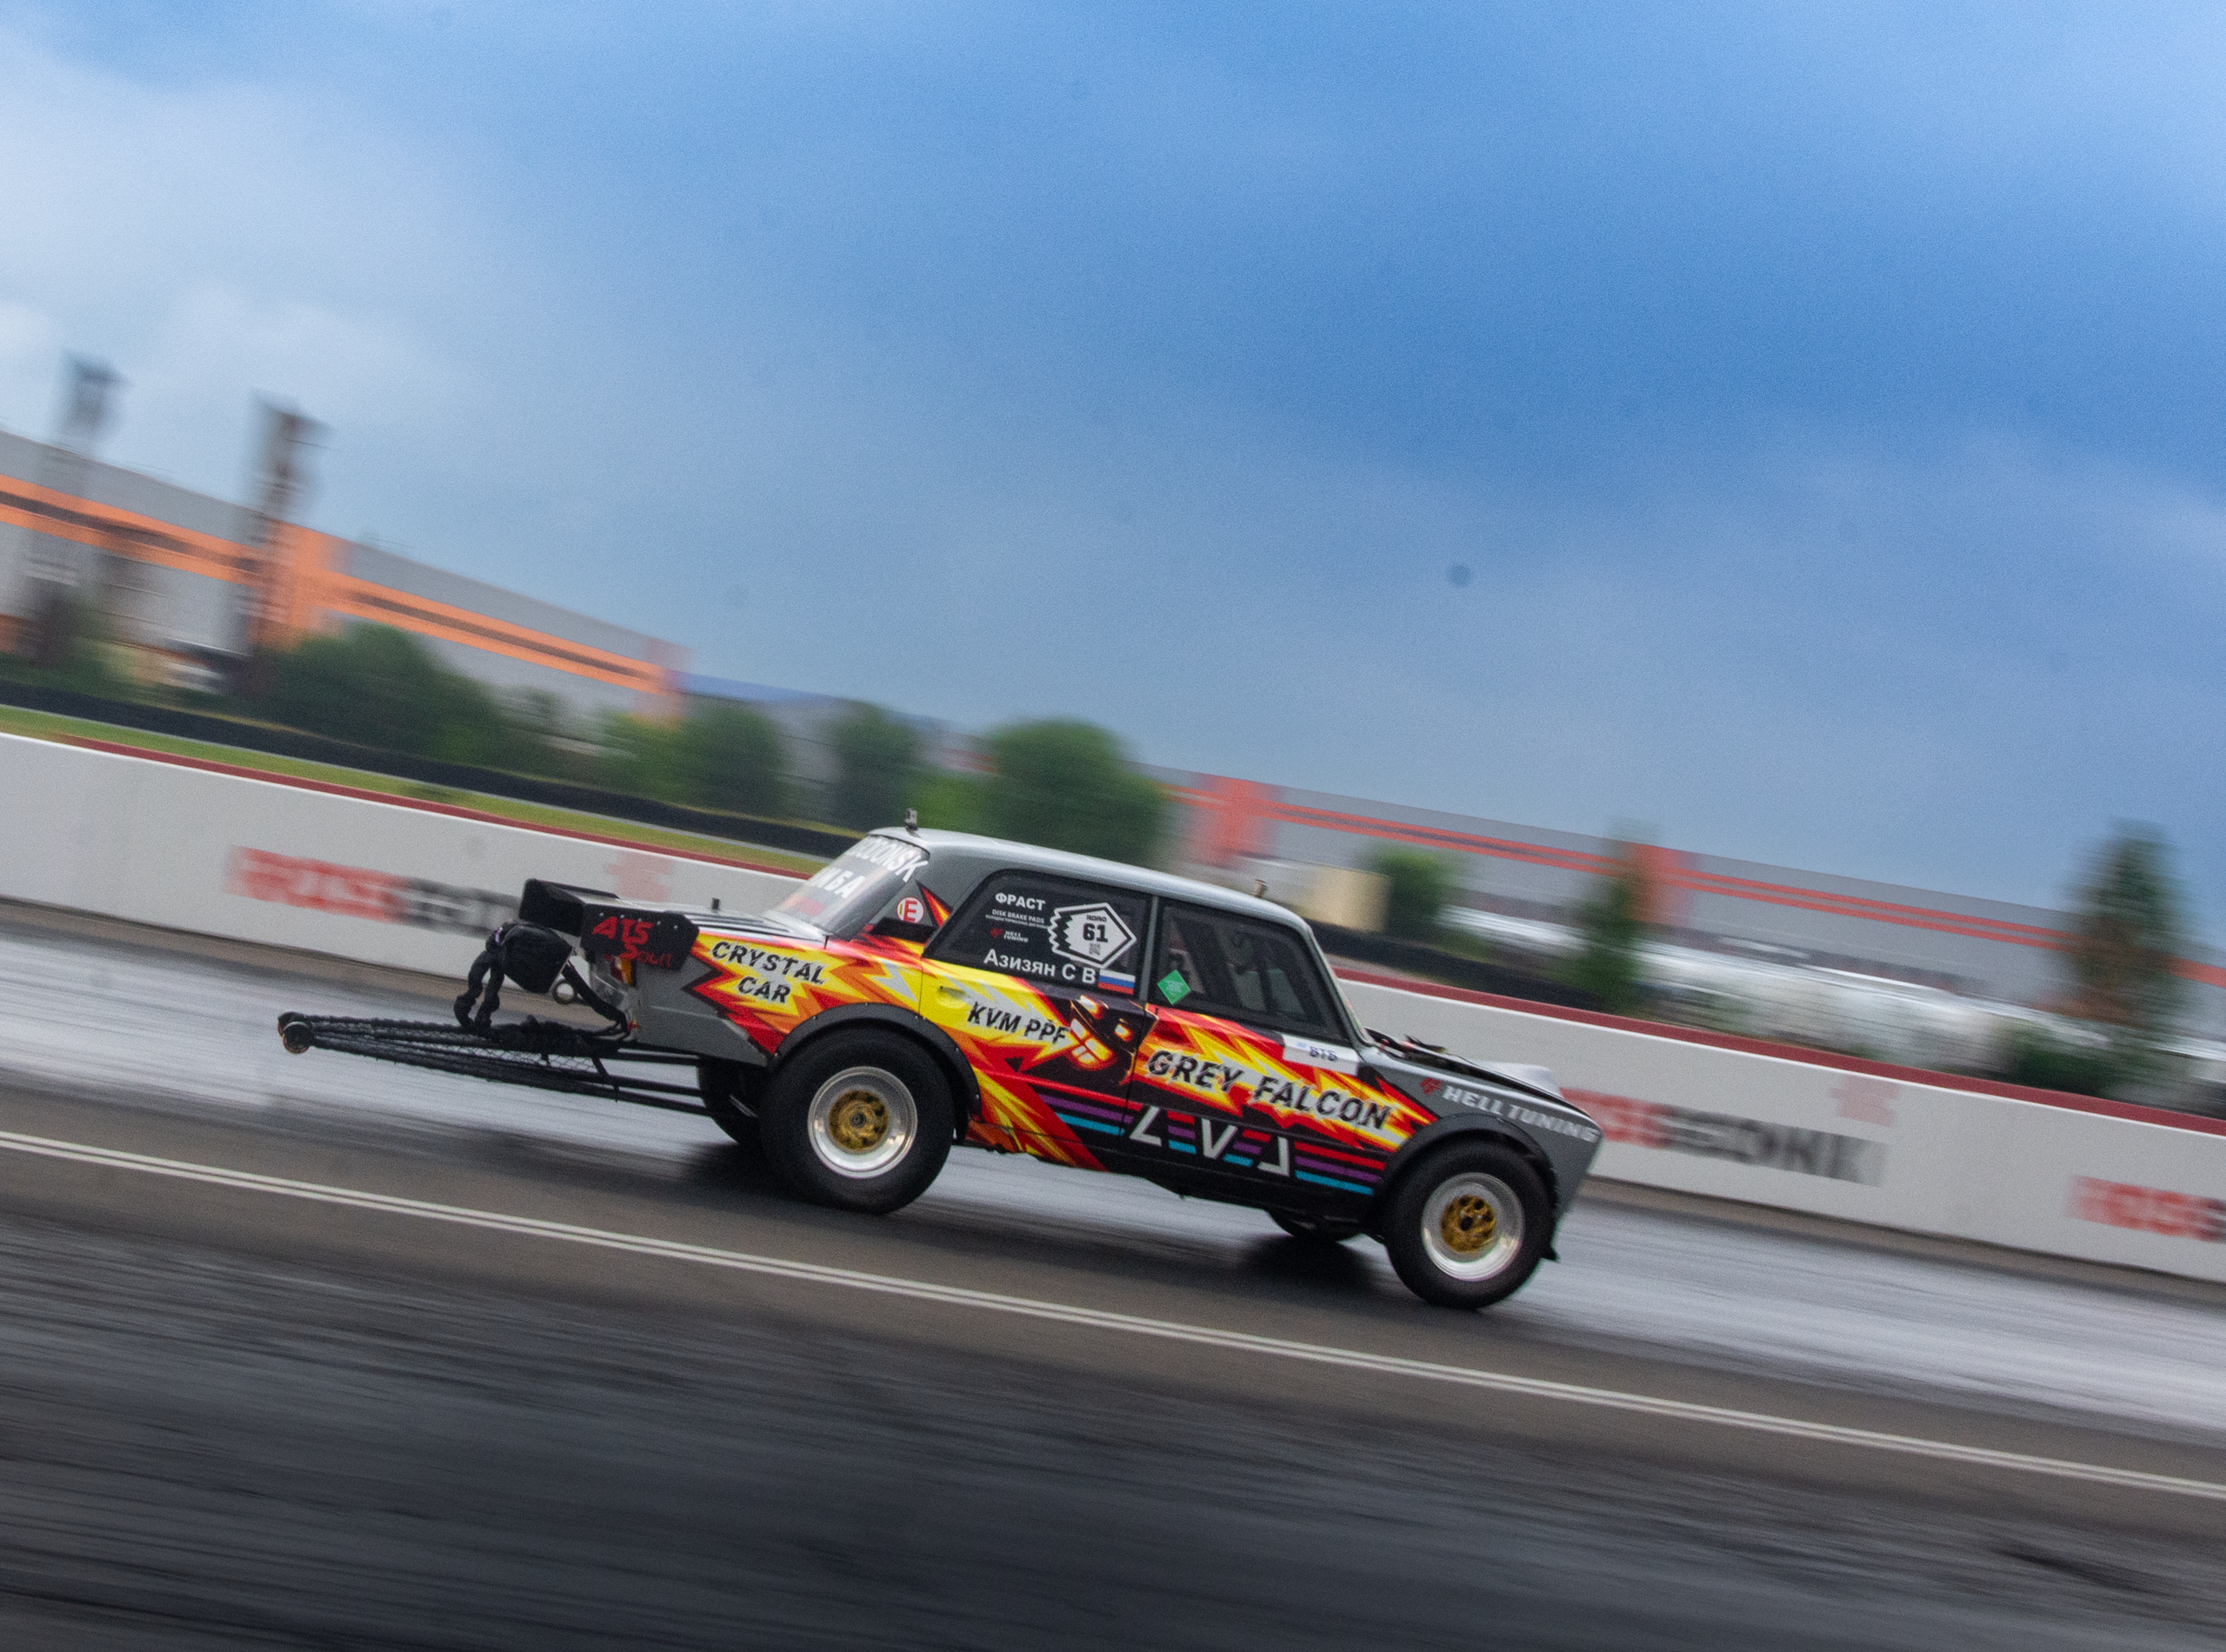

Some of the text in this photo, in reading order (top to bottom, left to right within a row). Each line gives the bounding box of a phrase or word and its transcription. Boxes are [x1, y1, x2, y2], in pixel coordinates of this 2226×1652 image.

[903, 899, 918, 923] E
[995, 892, 1046, 911] ФРАСТ
[991, 909, 1007, 917] DISK
[1007, 911, 1028, 921] BRAKE
[1028, 915, 1045, 924] PADS
[1083, 923, 1109, 943] 61
[710, 940, 827, 985] CRYSTAL
[983, 948, 1056, 978] Азизян
[736, 976, 791, 1003] CAR
[967, 1001, 1069, 1044] KVM PPF
[1146, 1049, 1392, 1131] GREY FALCON
[1442, 1085, 1505, 1116] HELL
